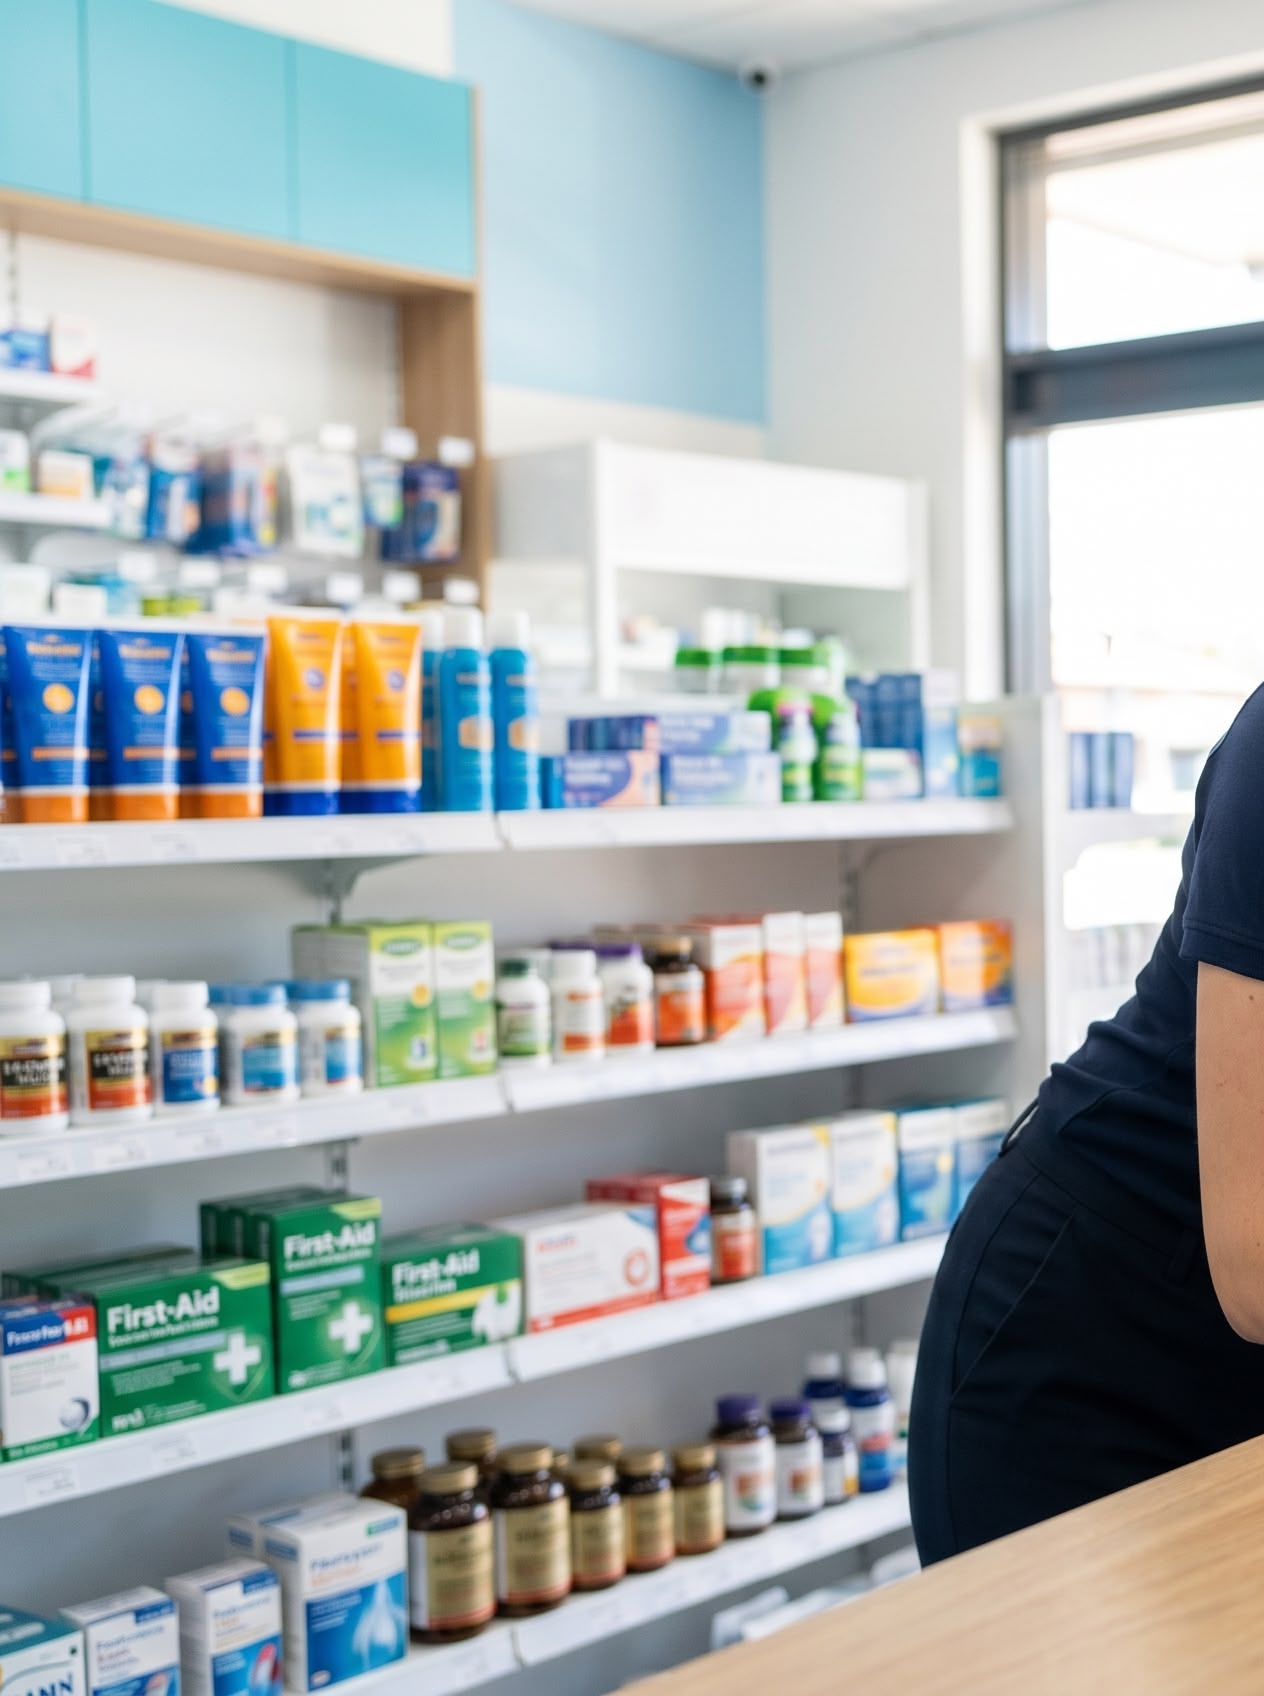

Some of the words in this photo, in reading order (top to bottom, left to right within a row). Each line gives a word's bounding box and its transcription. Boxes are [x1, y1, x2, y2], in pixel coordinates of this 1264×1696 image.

[284, 1221, 376, 1259] First-Aid
[392, 1247, 480, 1285] First-Aid
[107, 1285, 220, 1333] First-Aid
